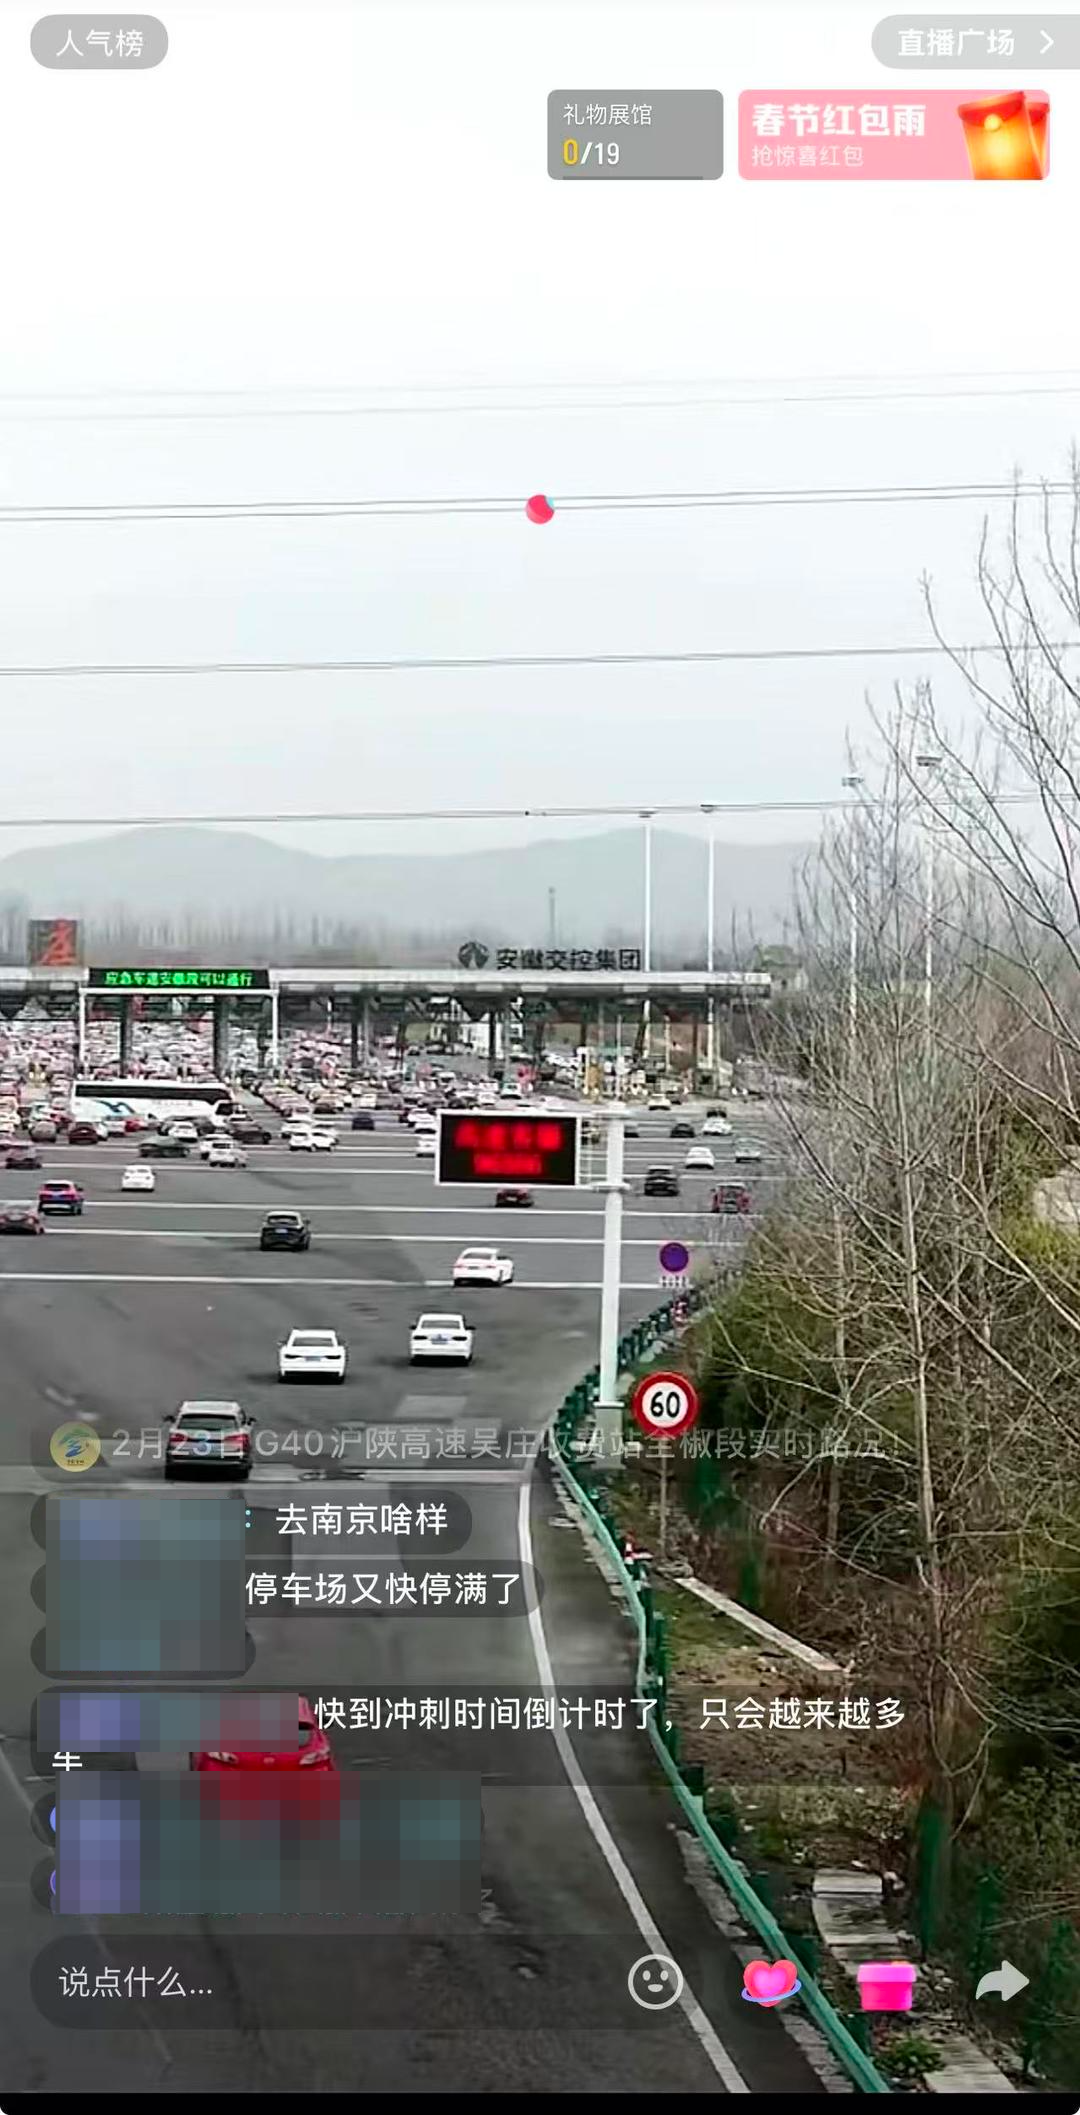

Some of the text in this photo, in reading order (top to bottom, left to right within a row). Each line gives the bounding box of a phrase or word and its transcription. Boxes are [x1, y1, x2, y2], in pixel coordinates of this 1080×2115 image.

[104, 971, 254, 987] 应急车道安段可以通行
[651, 1391, 680, 1418] 60
